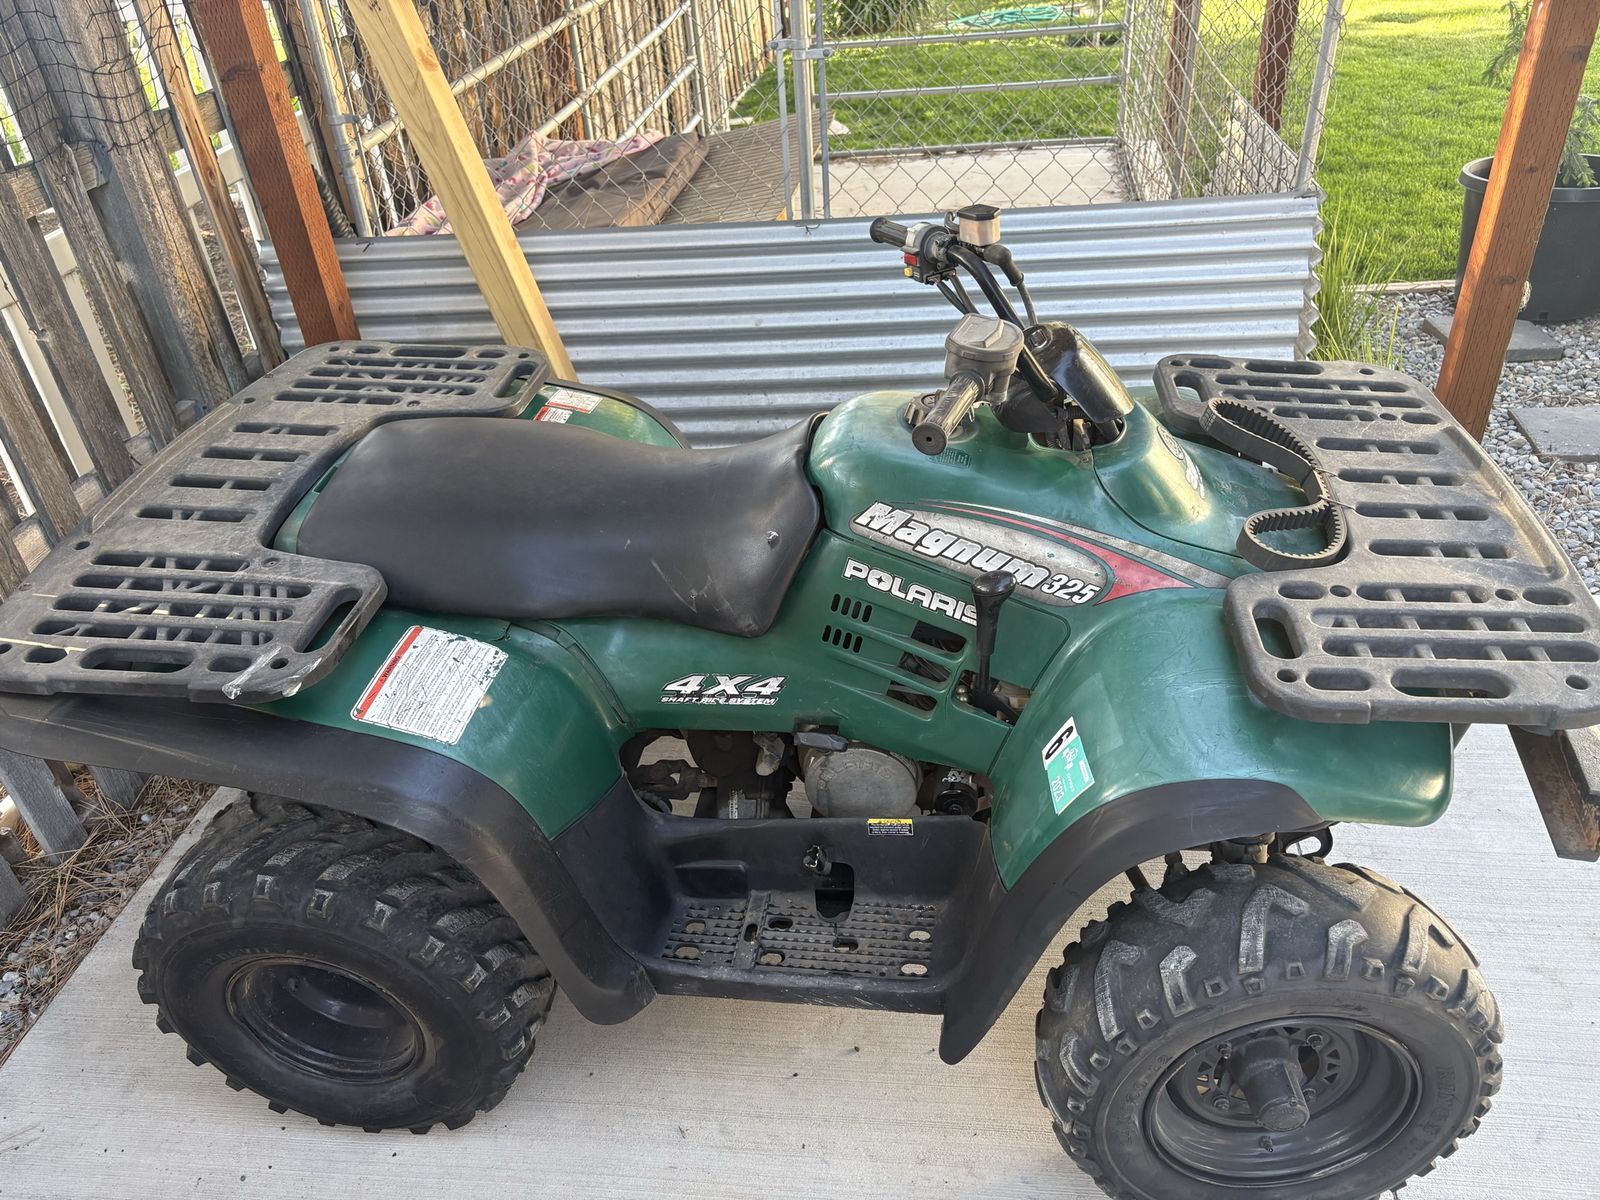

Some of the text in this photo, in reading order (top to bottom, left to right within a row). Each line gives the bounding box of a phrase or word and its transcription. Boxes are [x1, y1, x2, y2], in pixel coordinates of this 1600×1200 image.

[853, 500, 1101, 604] Magnum 325
[729, 696, 776, 706] SYSTEM
[1045, 726, 1073, 760] 6
